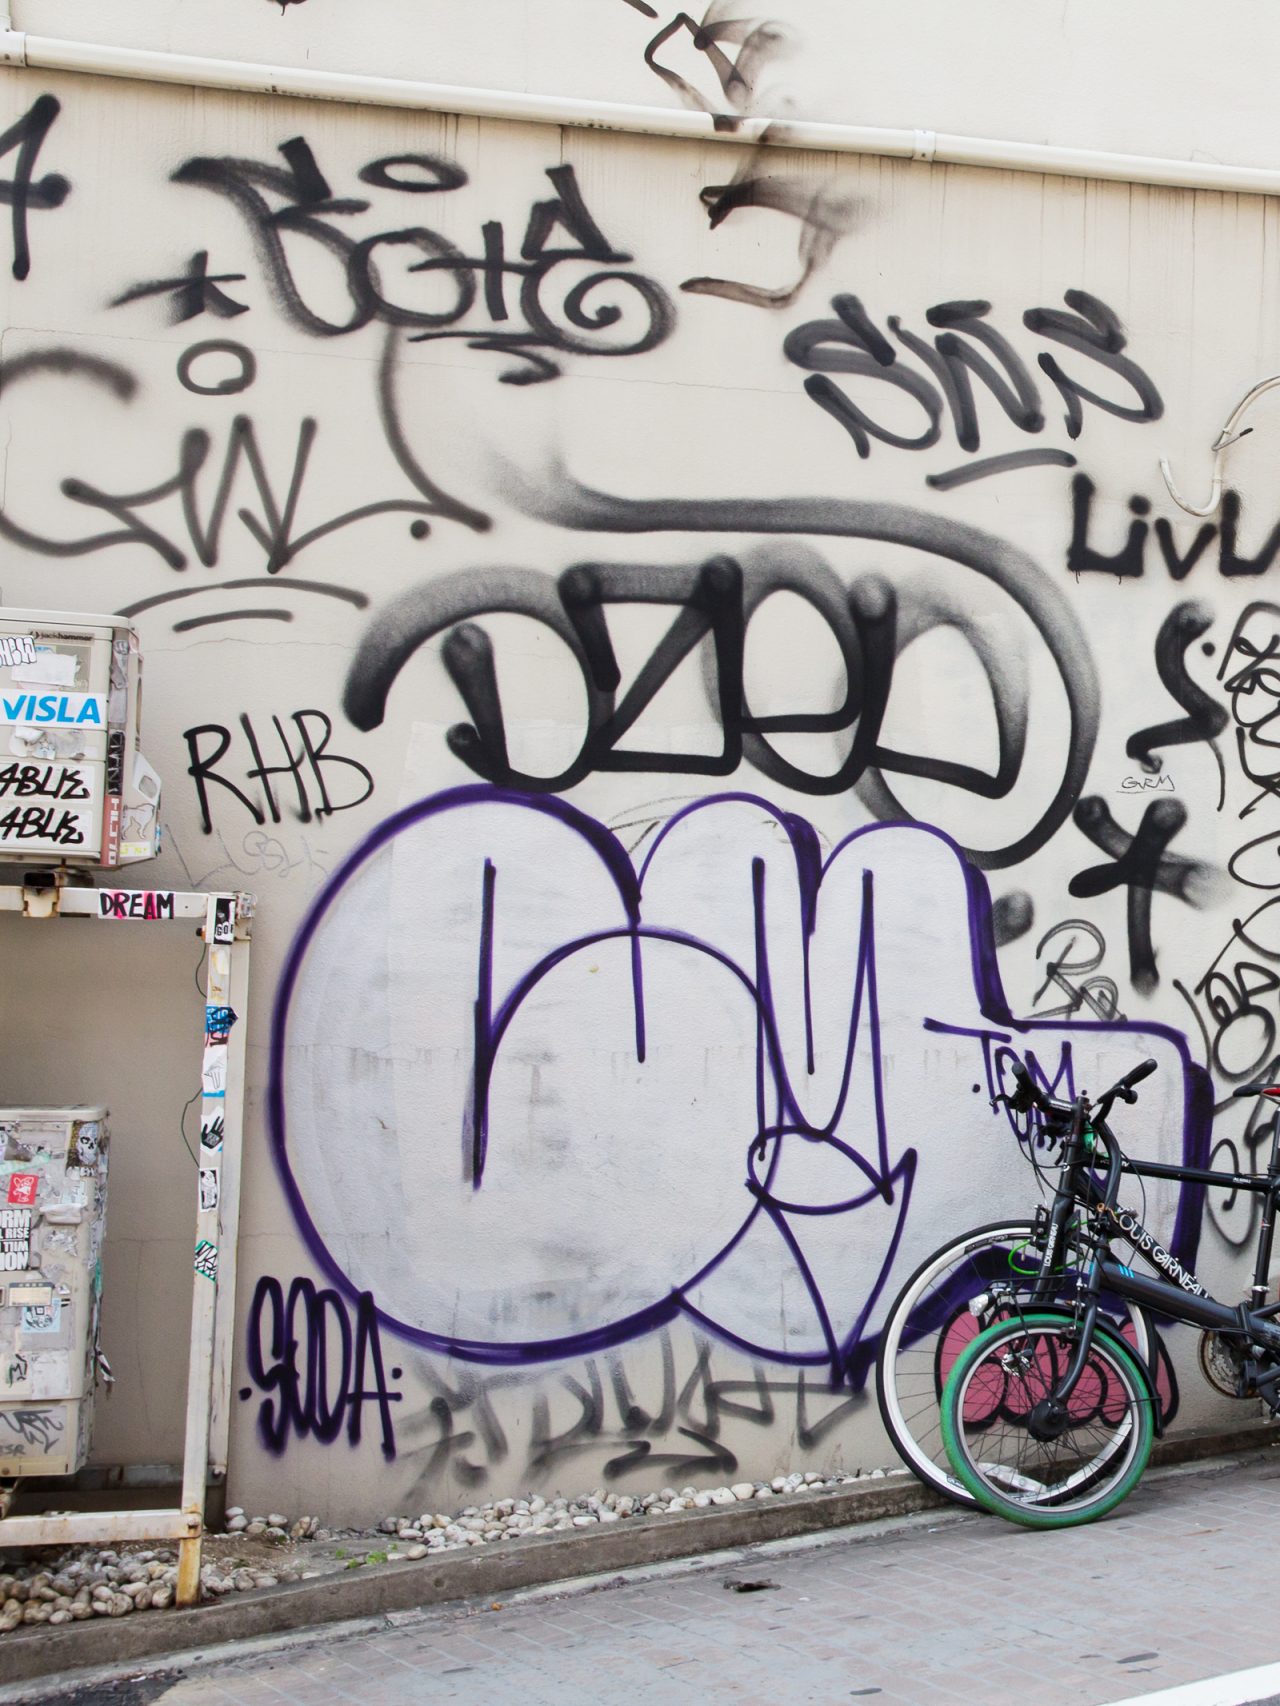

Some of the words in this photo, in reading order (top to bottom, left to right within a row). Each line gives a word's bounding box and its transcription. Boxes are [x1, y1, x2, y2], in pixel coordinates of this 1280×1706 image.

[2, 694, 101, 724] VISLA
[100, 891, 175, 919] DREAM
[1117, 1213, 1154, 1250] OUIS
